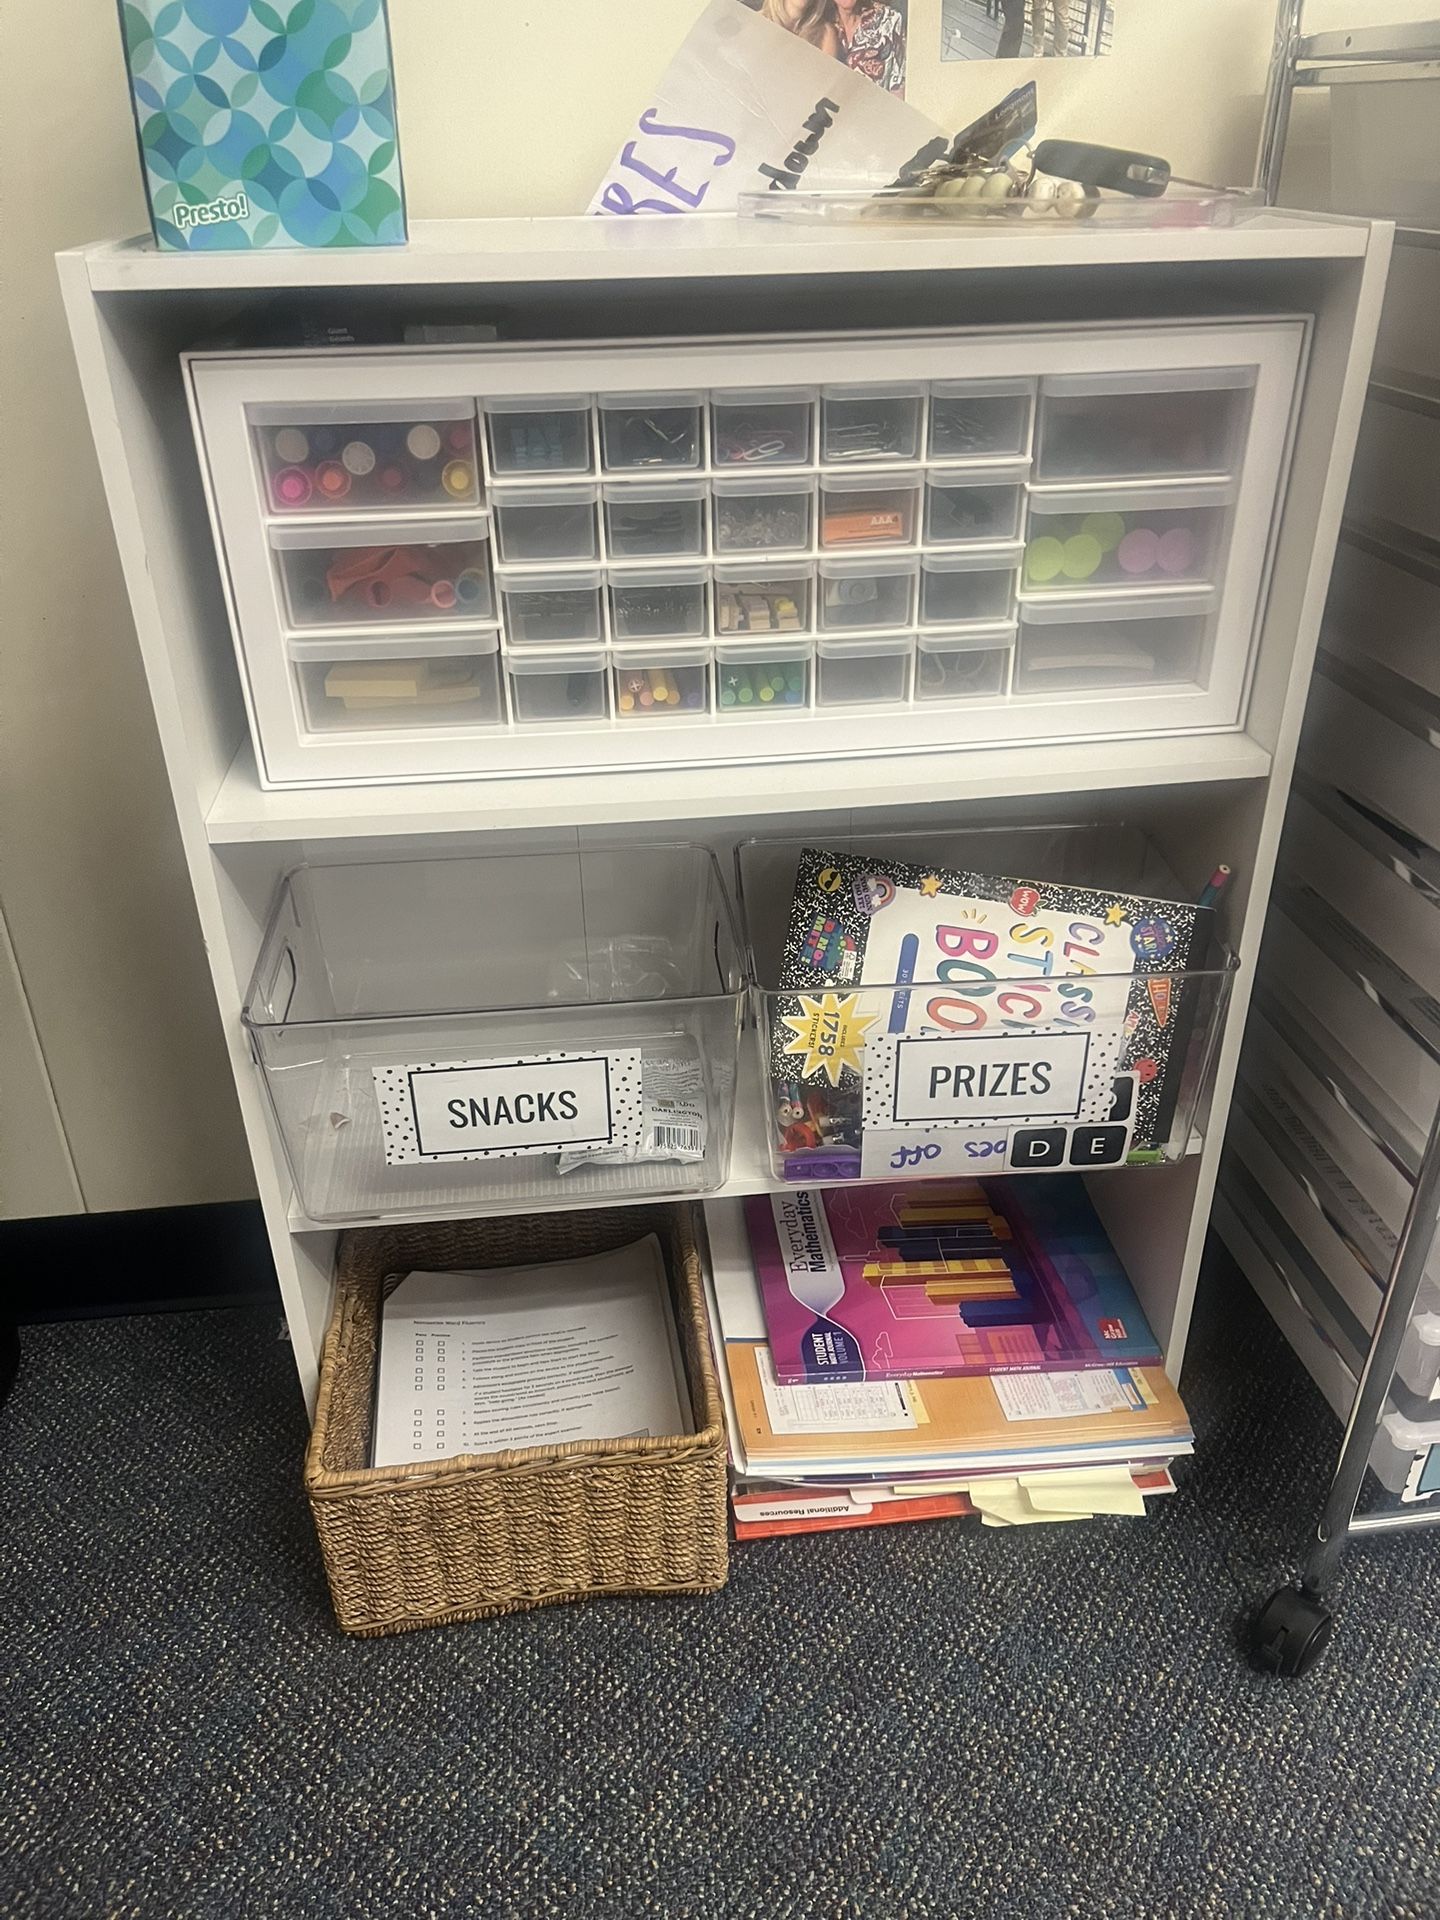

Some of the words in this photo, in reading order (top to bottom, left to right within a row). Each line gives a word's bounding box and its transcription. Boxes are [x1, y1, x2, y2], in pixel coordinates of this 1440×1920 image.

[173, 193, 249, 229] Presto!
[1017, 890, 1032, 913] WOW
[921, 924, 999, 1032] BOO
[808, 1012, 820, 1049] STICKERS!
[818, 1012, 840, 1056] 1758
[929, 1061, 1053, 1099] PRIZES
[448, 1090, 579, 1129] SNACKS
[890, 1143, 942, 1169] off
[1028, 1139, 1049, 1157] D
[1089, 1137, 1105, 1155] E
[779, 1201, 809, 1273] Everyday
[795, 1191, 827, 1273] Mathematics
[811, 1333, 829, 1366] STUDENT
[835, 1337, 849, 1365] VOLUME
[759, 1508, 805, 1518] Resources
[807, 1505, 849, 1515] Additional
